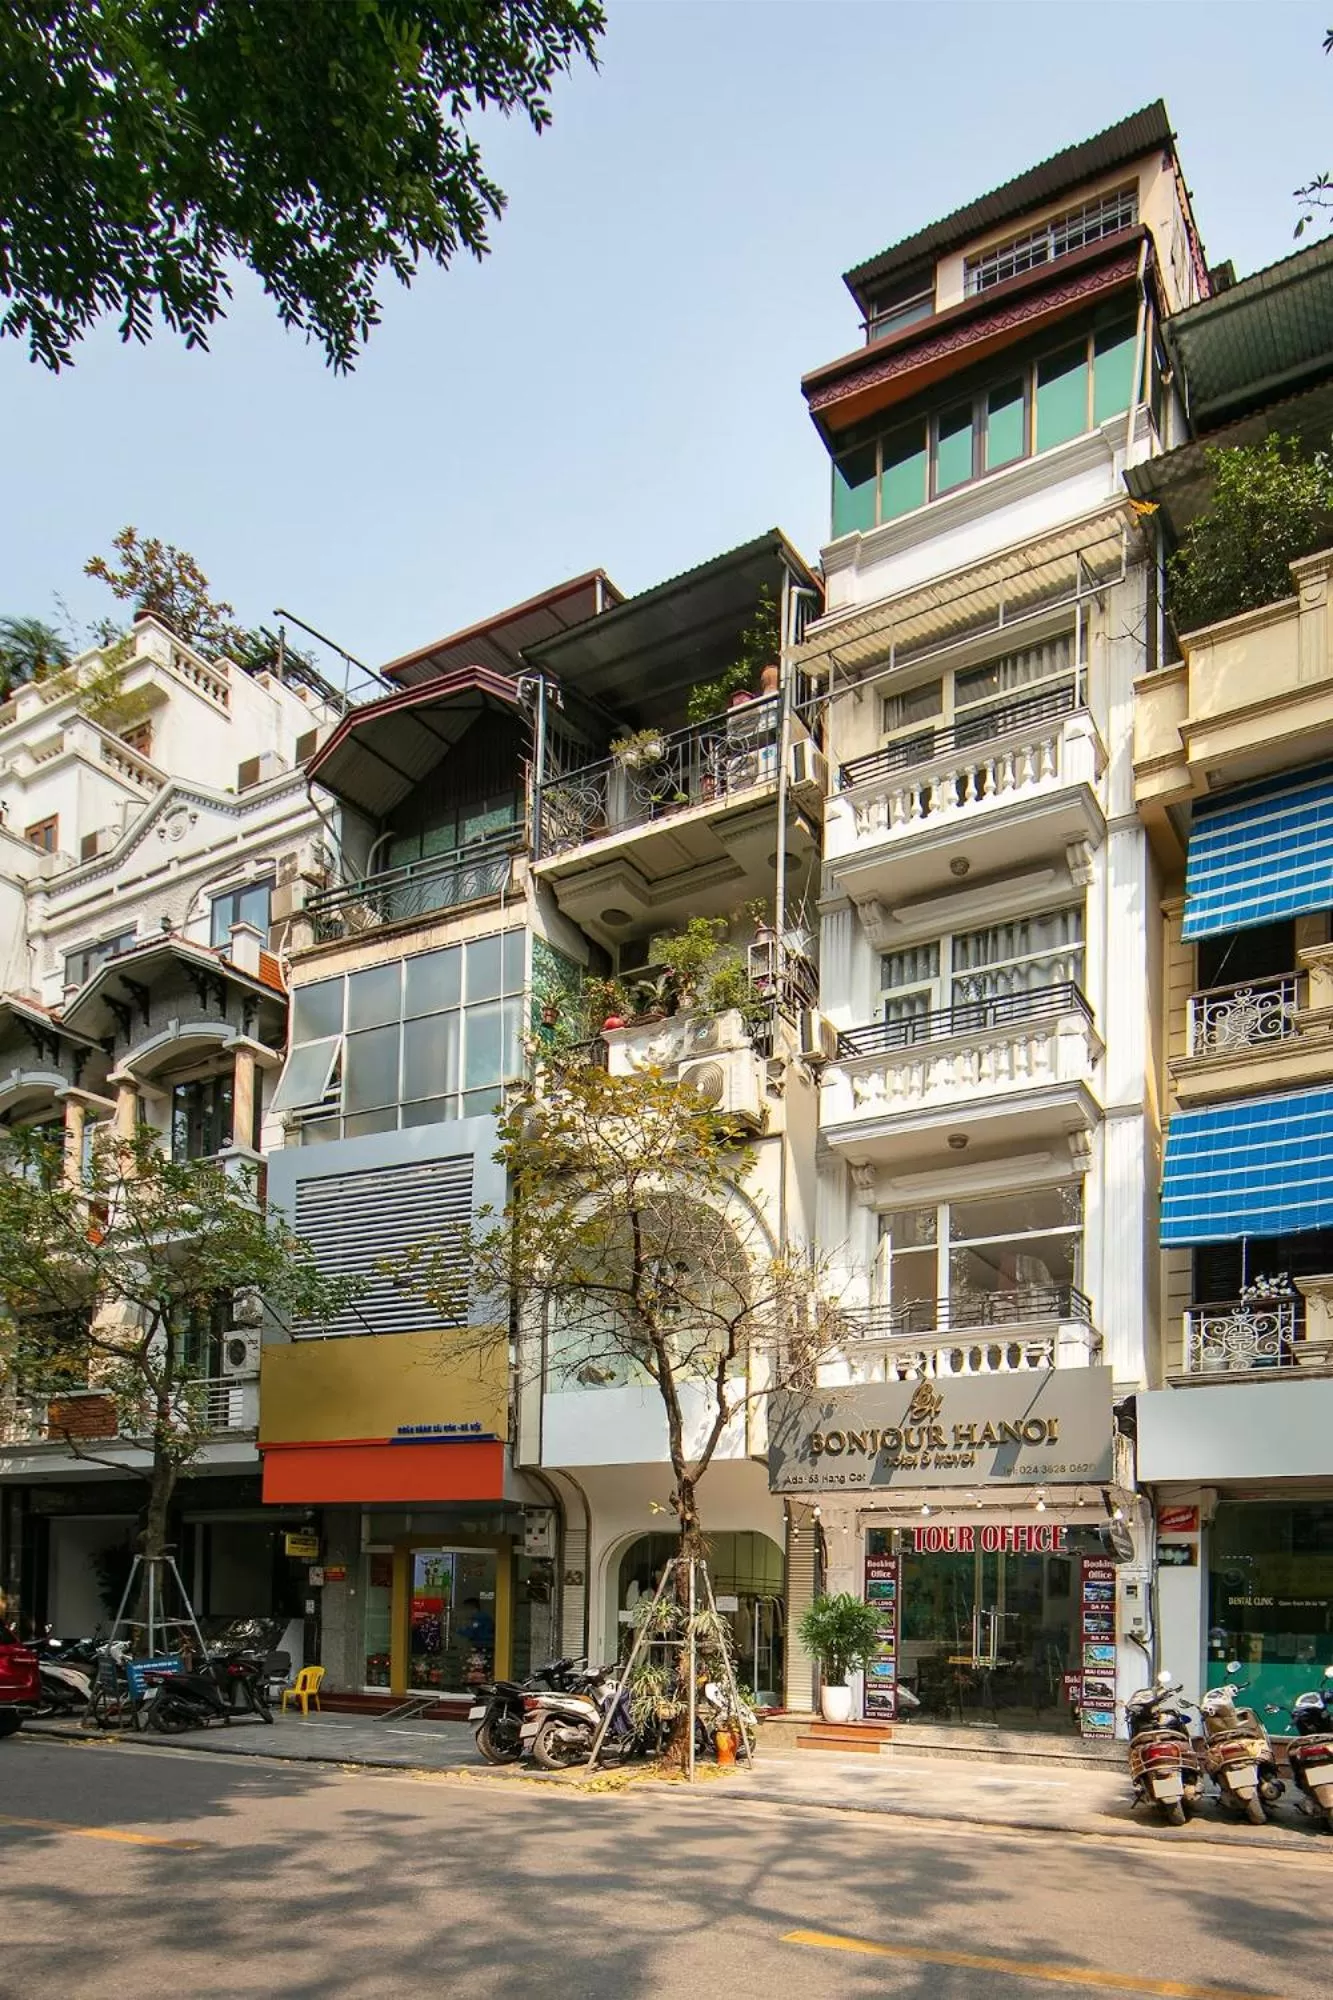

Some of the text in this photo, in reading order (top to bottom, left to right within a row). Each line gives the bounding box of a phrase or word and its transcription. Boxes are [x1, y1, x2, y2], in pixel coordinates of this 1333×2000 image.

[809, 1418, 1060, 1460] BONJOUR HANOI
[934, 1450, 977, 1469] travel
[1019, 1464, 1039, 1474] 024
[912, 1524, 1068, 1553] TOUR OFFICE
[867, 1559, 896, 1570] Booking
[871, 1570, 893, 1578] Office
[1088, 1570, 1112, 1580] Office
[1228, 1596, 1274, 1606] DENTAL CLINIC
